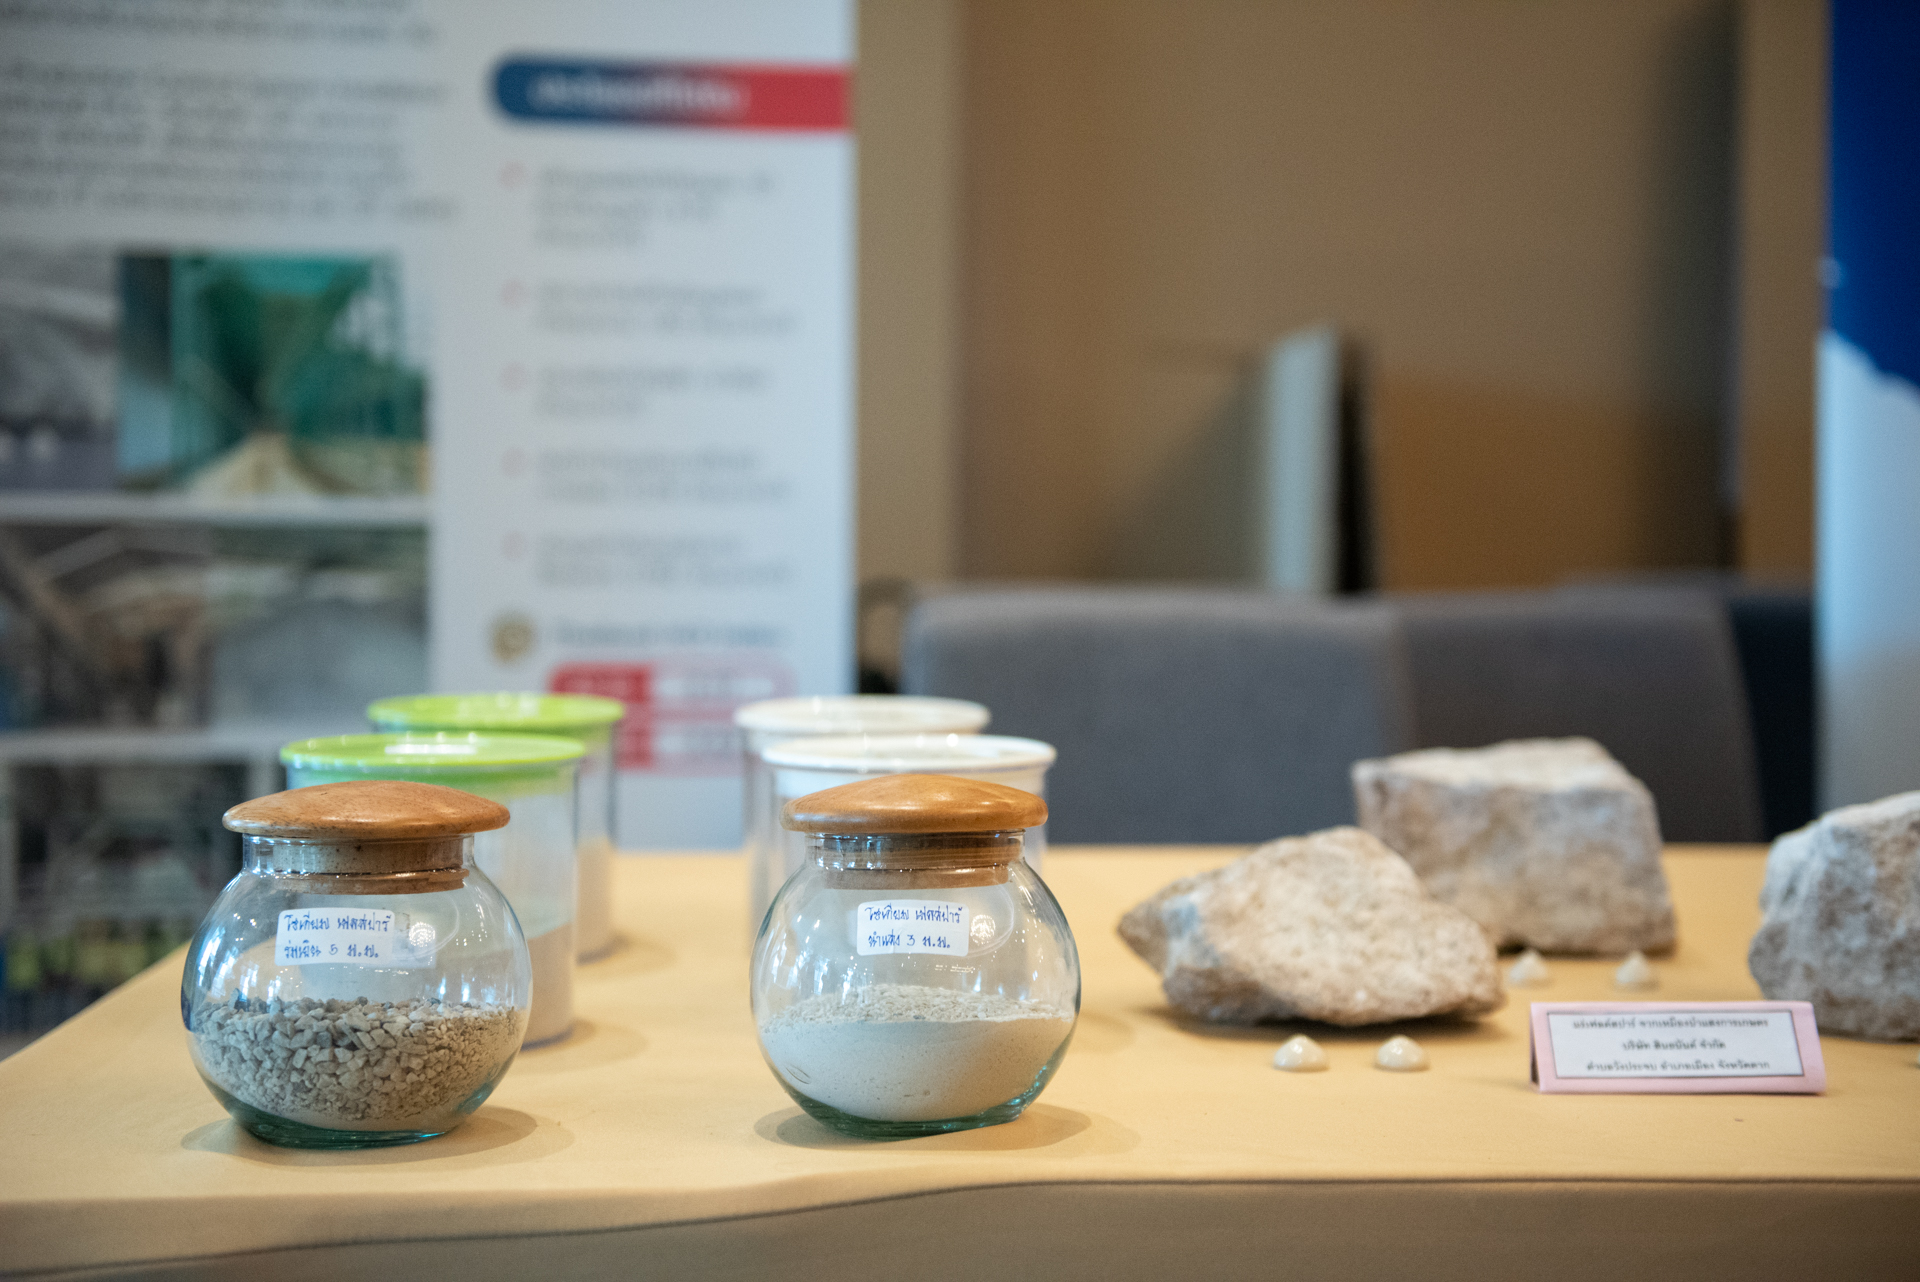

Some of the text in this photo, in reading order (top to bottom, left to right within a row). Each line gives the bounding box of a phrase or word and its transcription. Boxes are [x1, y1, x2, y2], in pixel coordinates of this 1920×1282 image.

[906, 934, 916, 947] 3
[329, 943, 338, 956] 5
[1623, 1038, 1651, 1050] บริษัท
[1700, 1038, 1727, 1050] จำกัด
[1587, 1058, 1770, 1072] ตำบลวังประจบ อำเภอเมือง จังหวัดตาก
